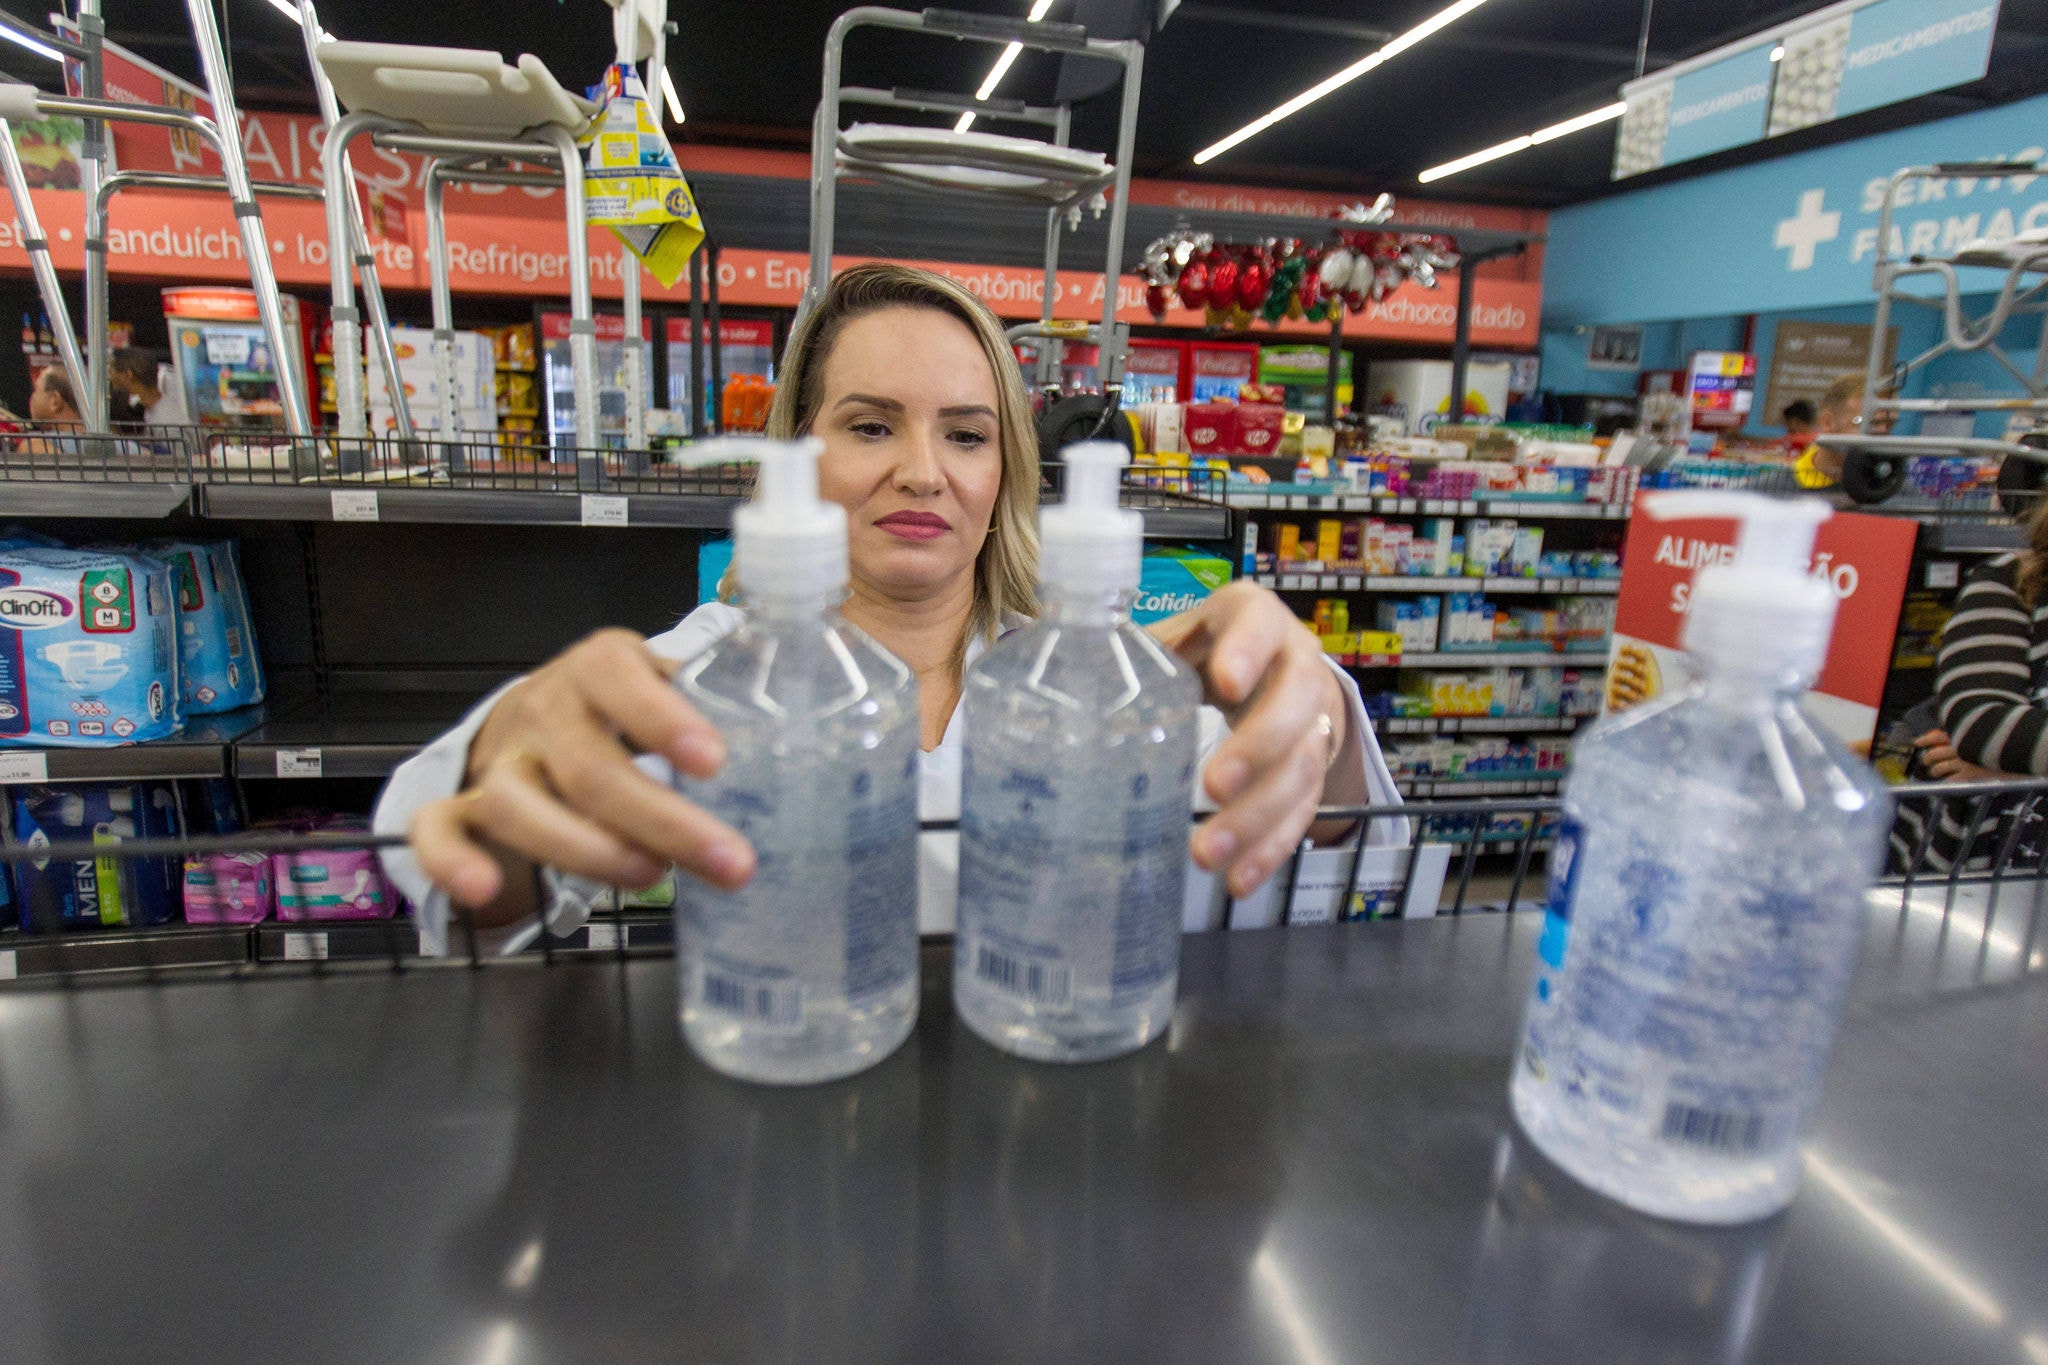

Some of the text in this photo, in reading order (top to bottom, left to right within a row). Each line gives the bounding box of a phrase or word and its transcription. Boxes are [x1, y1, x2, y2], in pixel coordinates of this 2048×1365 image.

[86, 225, 248, 259] anduích
[1370, 296, 1526, 331] Achocotado
[1654, 532, 1859, 600] ALIMEÃO
[0, 599, 56, 617] ClinOff
[75, 859, 98, 917] MEN
